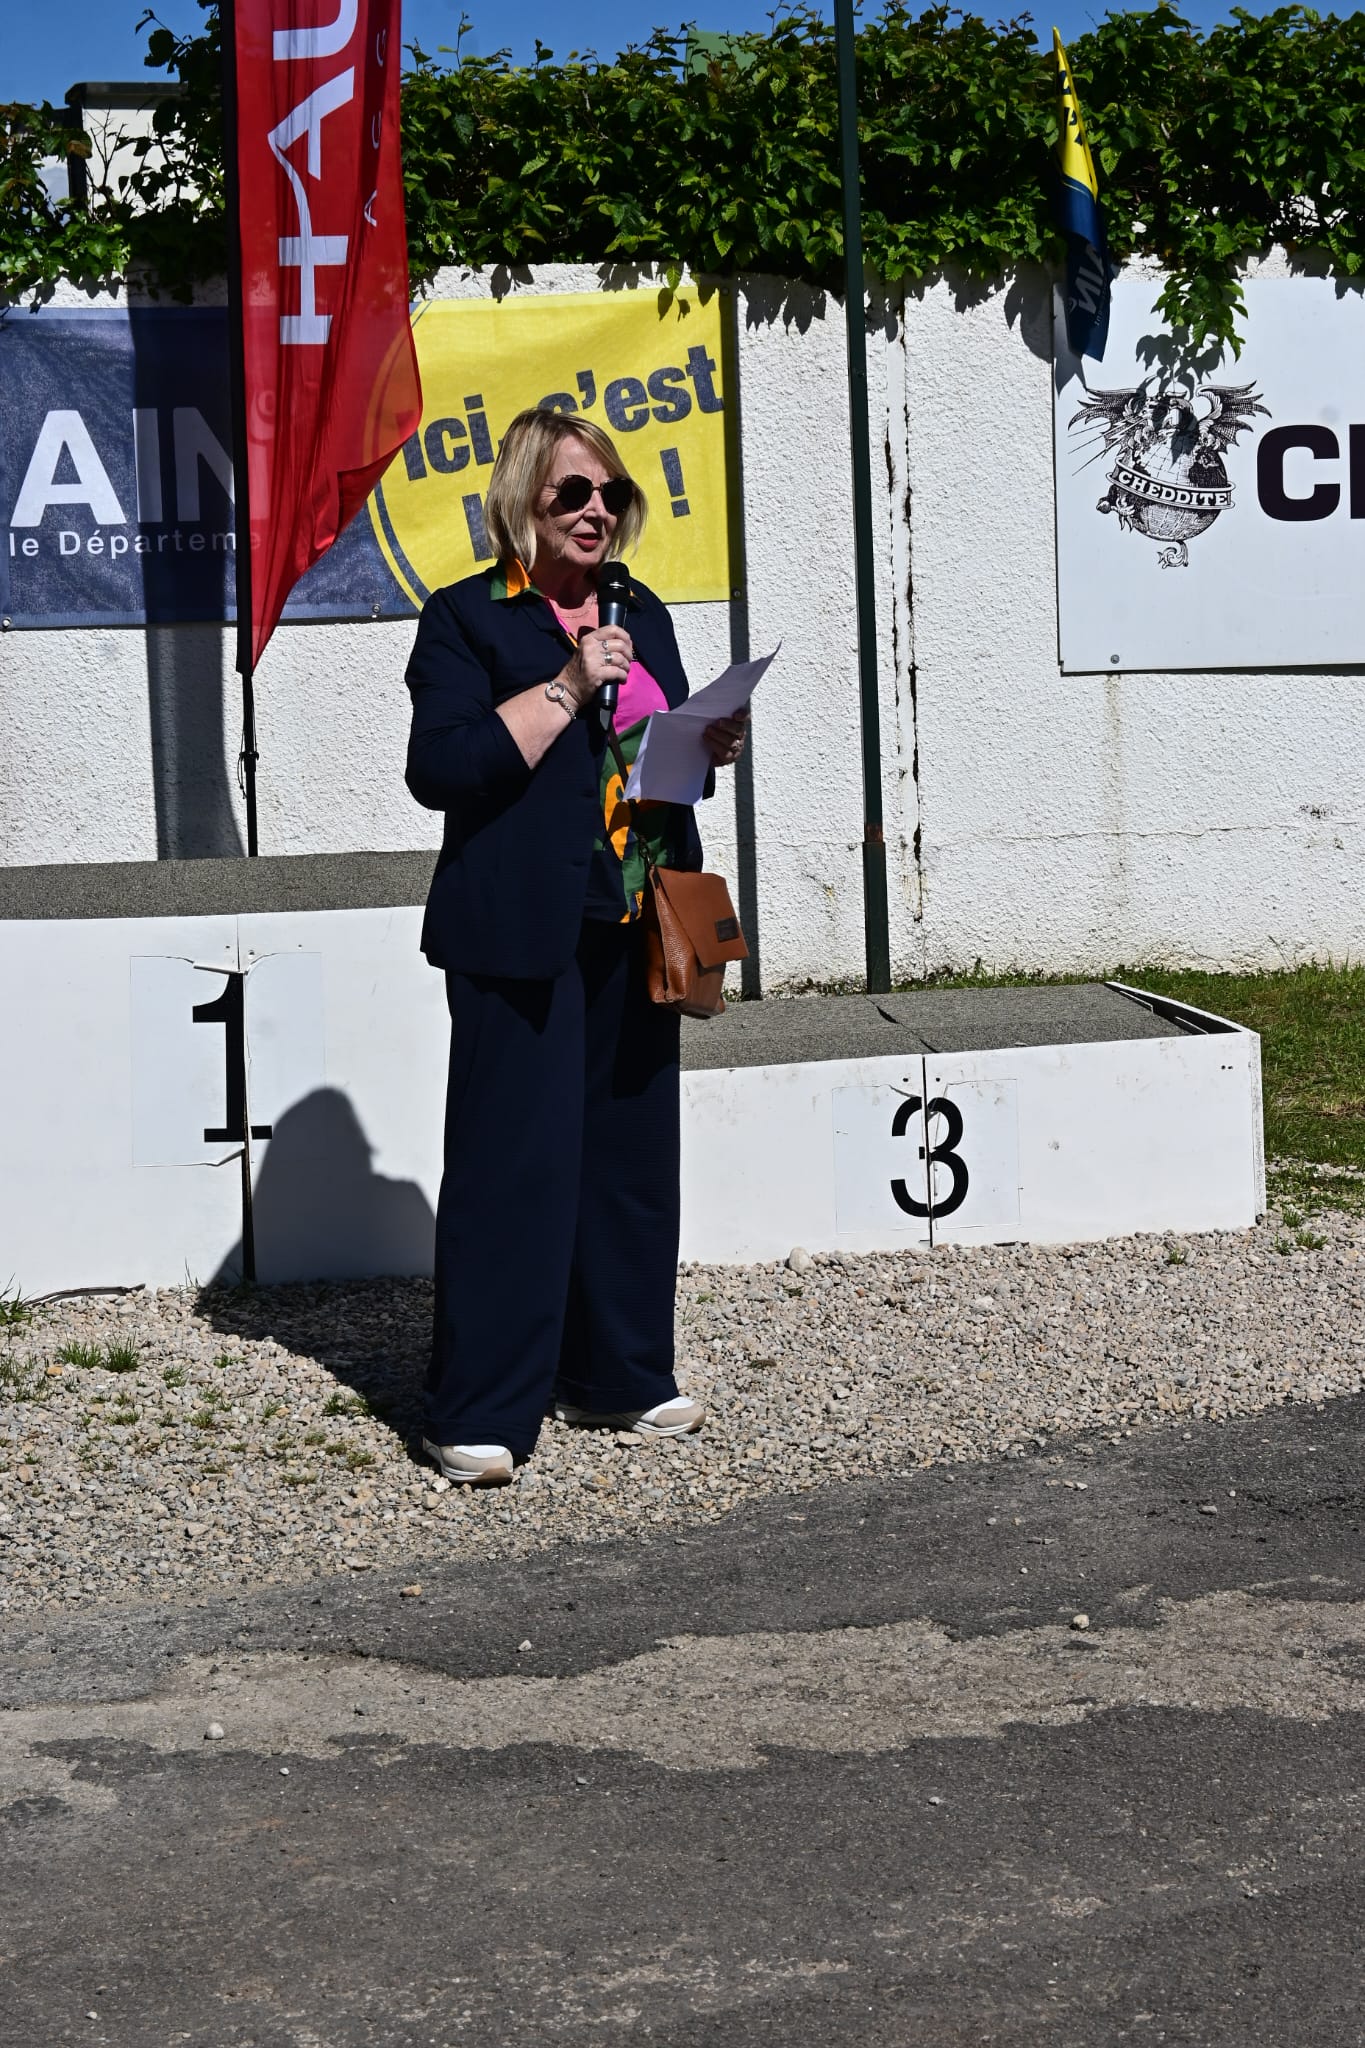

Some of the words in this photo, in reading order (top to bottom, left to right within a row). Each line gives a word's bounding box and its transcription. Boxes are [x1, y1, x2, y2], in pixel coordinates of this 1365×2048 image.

[10, 406, 268, 527] AIN
[402, 394, 505, 481] ici
[1257, 423, 1365, 522] C
[1118, 470, 1228, 506] CHEDDITE
[9, 532, 39, 557] le
[192, 973, 273, 1143] 1
[890, 1097, 969, 1219] 3
